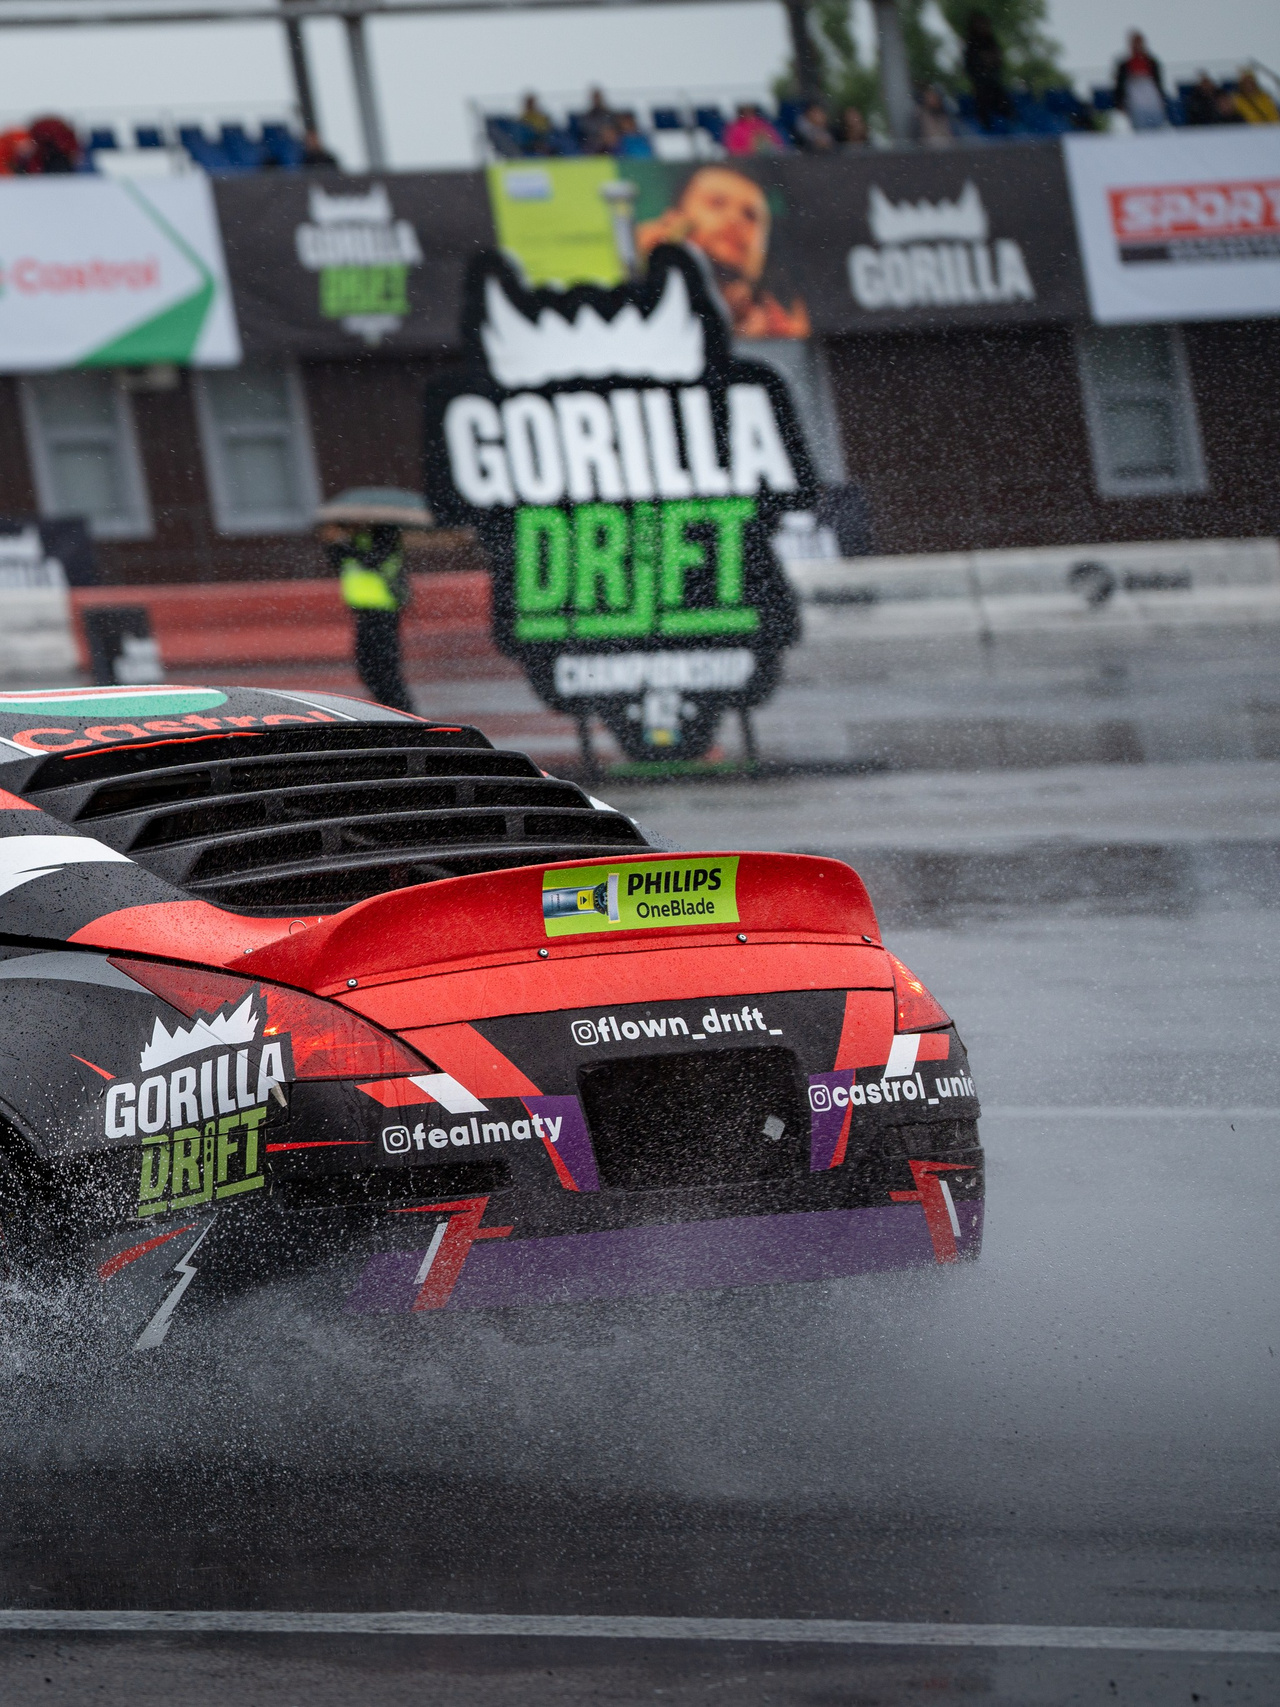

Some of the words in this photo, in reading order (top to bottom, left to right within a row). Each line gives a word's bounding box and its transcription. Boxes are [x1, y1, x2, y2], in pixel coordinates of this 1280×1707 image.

[14, 256, 159, 295] Castrol
[849, 238, 1035, 311] GORILLA
[445, 382, 798, 507] GORILLA
[515, 496, 760, 642] DRIFT
[627, 867, 722, 896] PHILIPS
[636, 897, 716, 919] OneBlade
[104, 1041, 290, 1139] GORILLA
[136, 1106, 267, 1219] DRIFT
[412, 1111, 563, 1151] fealmaty
